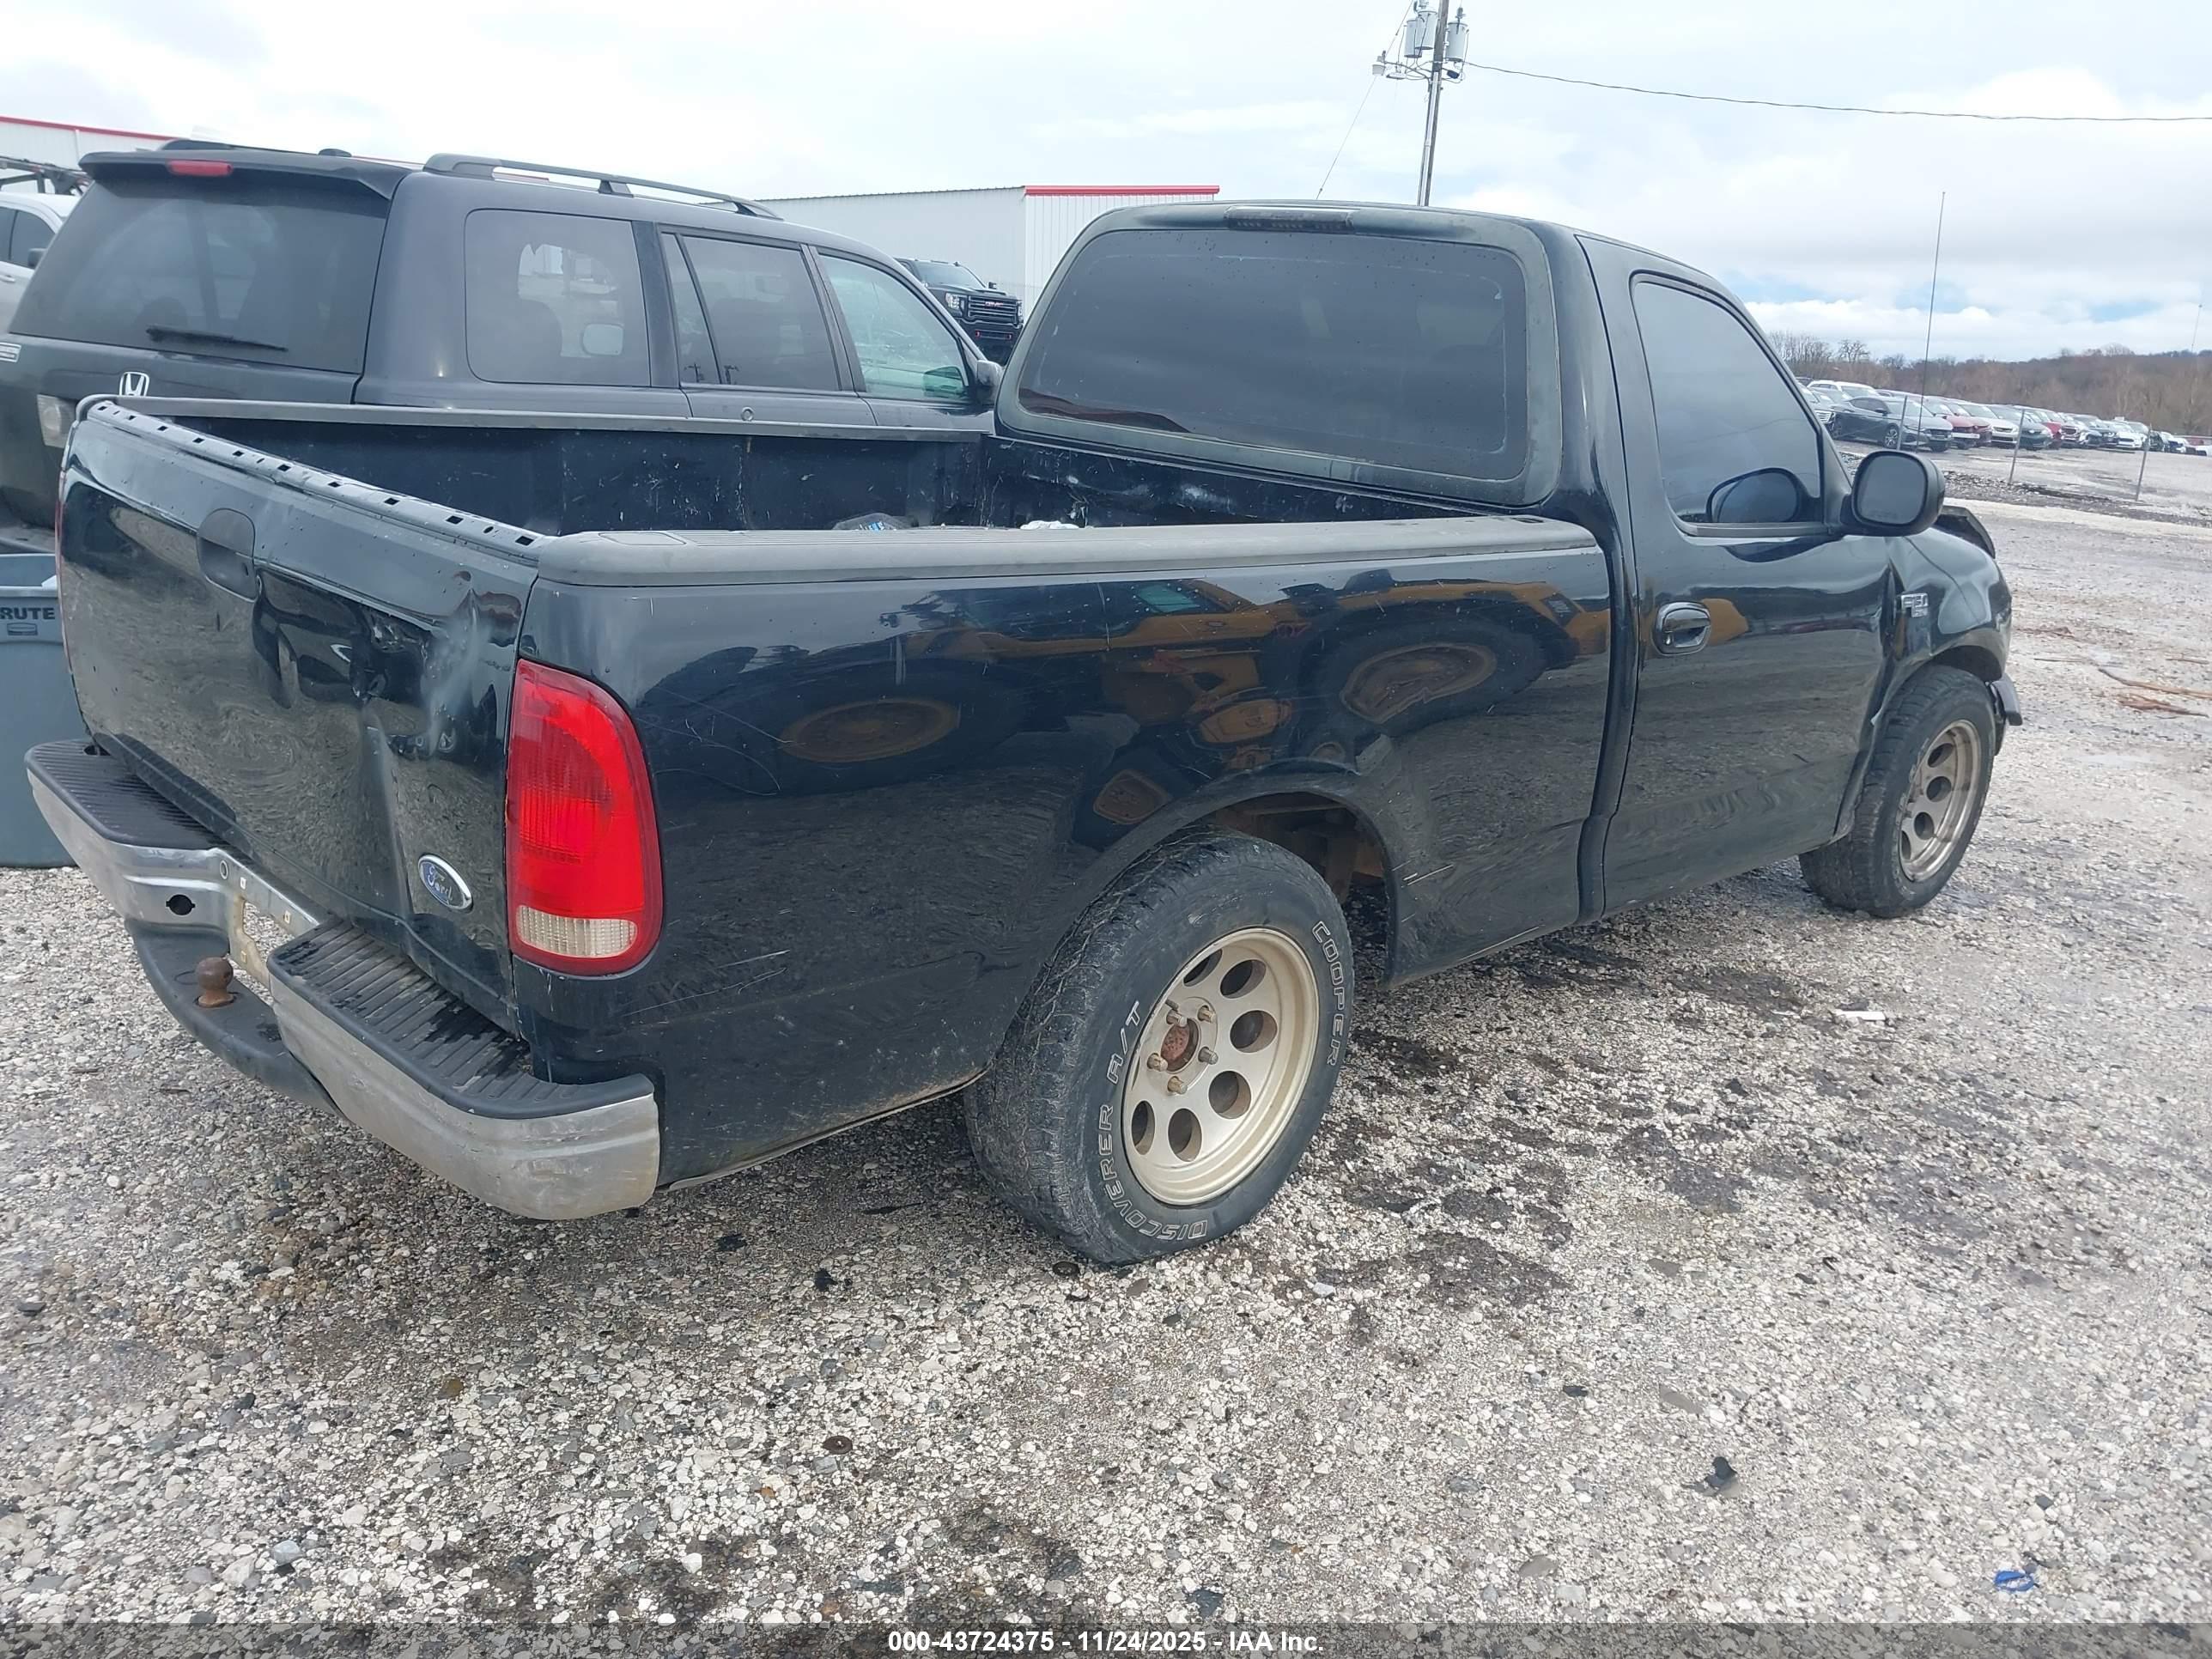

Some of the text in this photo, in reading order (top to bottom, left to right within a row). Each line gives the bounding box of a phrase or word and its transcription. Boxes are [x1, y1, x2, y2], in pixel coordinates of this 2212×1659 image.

[1311, 921, 1346, 1066] COOPER
[1098, 1000, 1209, 1241] DISCOVERER A/T
